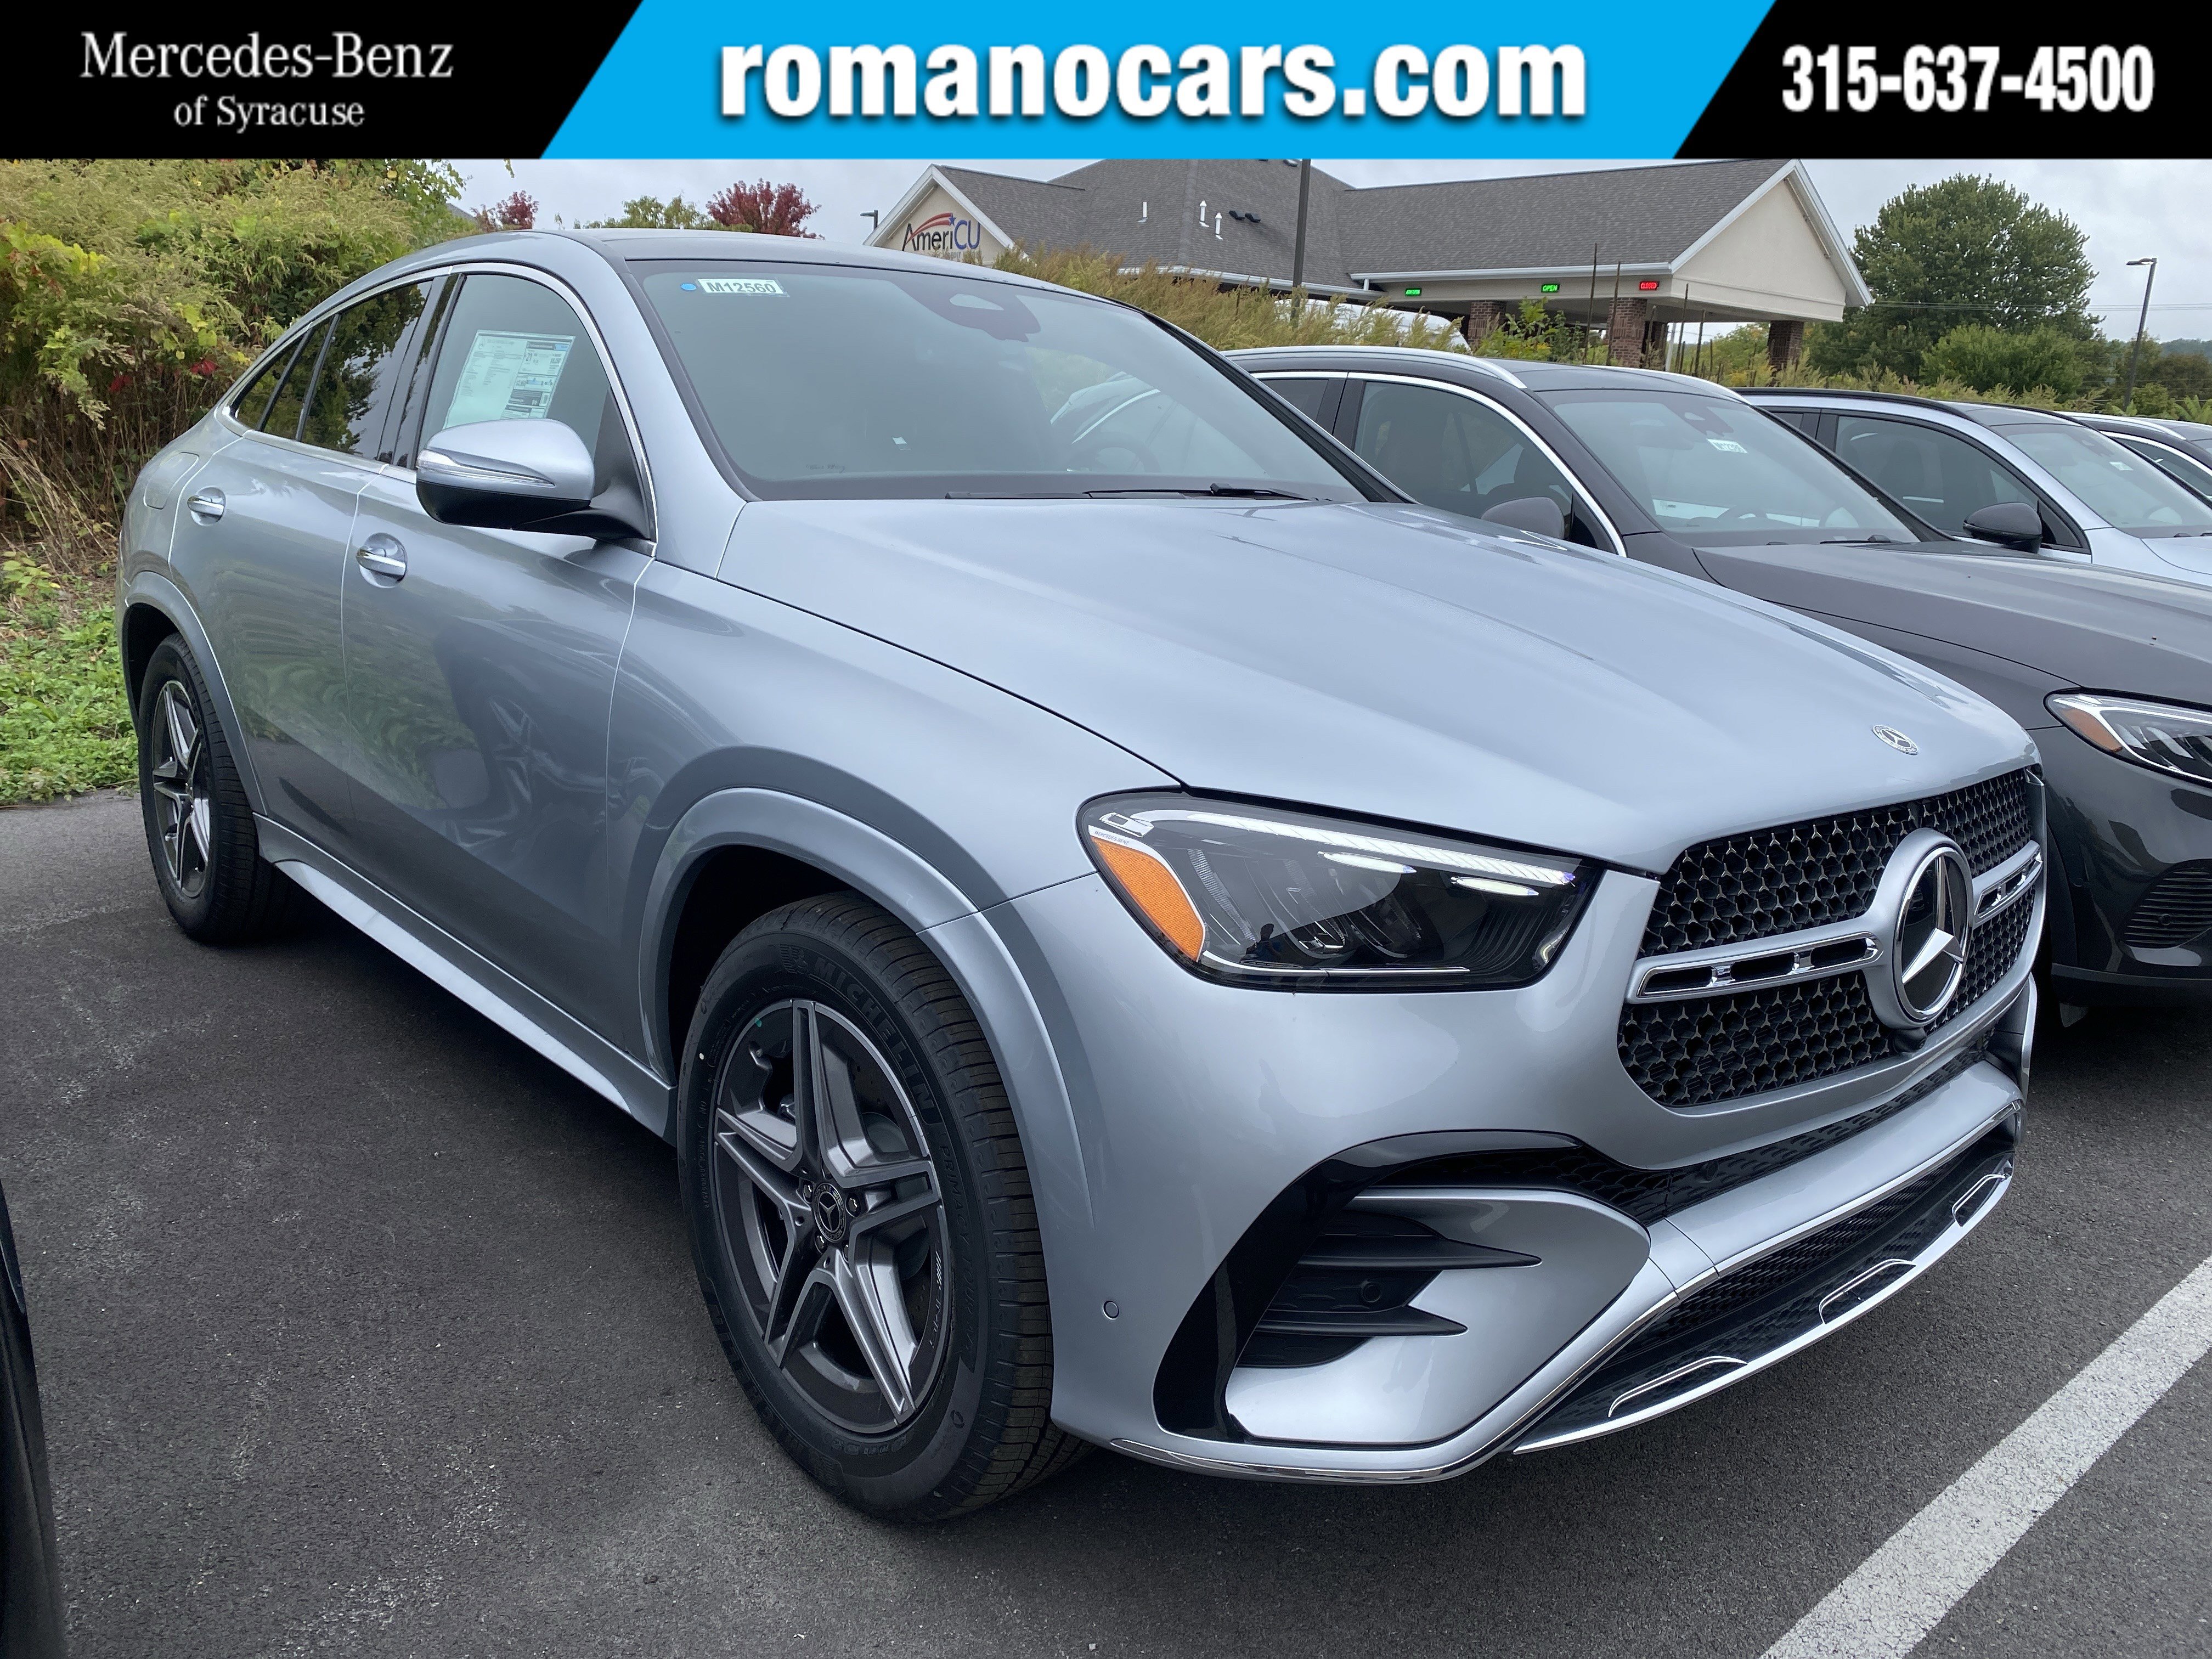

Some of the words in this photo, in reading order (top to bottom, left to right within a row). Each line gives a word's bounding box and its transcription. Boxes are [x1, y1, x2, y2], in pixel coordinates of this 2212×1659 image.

[902, 219, 980, 251] AmeriCU
[706, 281, 777, 293] M12560
[1094, 831, 1130, 845] MERCEDES-BENZ
[814, 956, 935, 1110] MICHELIN
